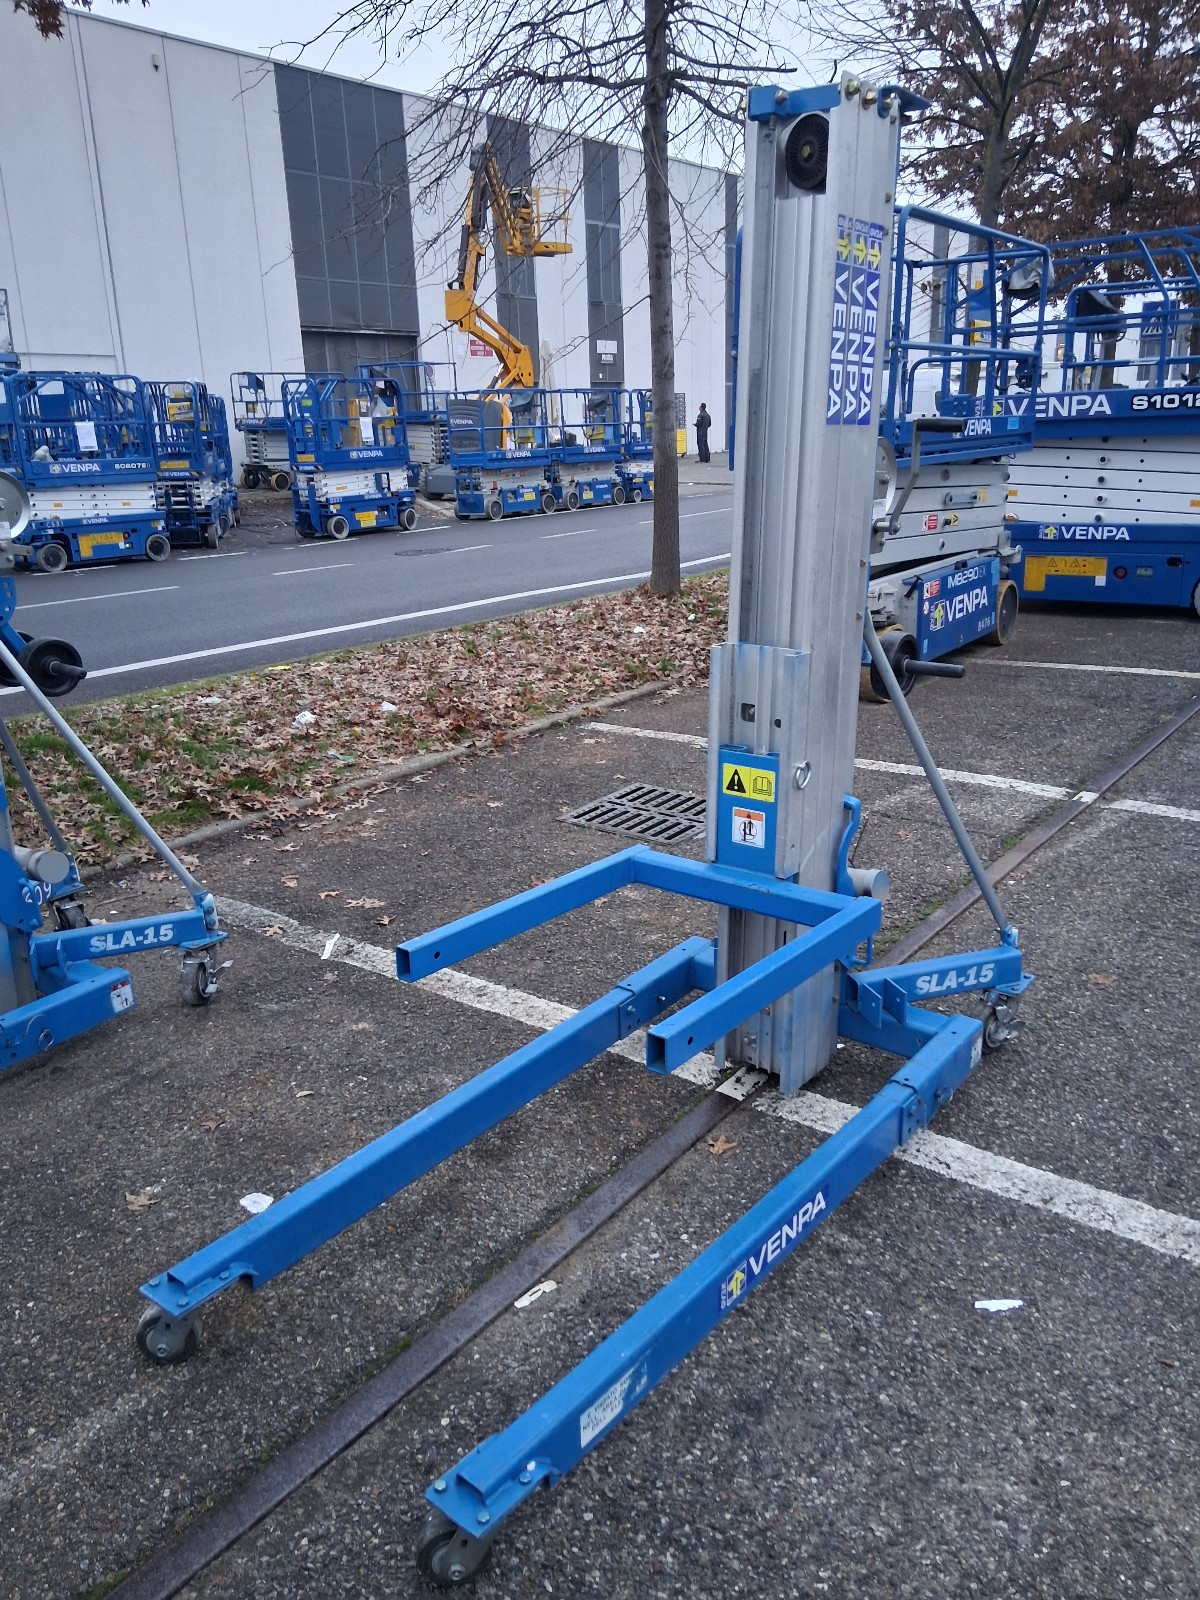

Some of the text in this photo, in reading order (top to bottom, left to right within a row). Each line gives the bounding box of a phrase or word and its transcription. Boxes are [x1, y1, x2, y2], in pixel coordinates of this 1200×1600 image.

[828, 271, 849, 419] VENPA
[843, 273, 865, 419] VENPA
[858, 278, 880, 420] VENPA
[1008, 395, 1112, 418] VENPA
[62, 463, 100, 473] VENPA
[357, 450, 384, 458] VENPA
[87, 517, 109, 525] VENPA
[1061, 525, 1130, 540] VENPA
[946, 585, 989, 622] VENPA
[89, 923, 174, 953] SLA-15
[915, 963, 996, 995] SLA-15
[748, 1191, 826, 1275] VENPA
